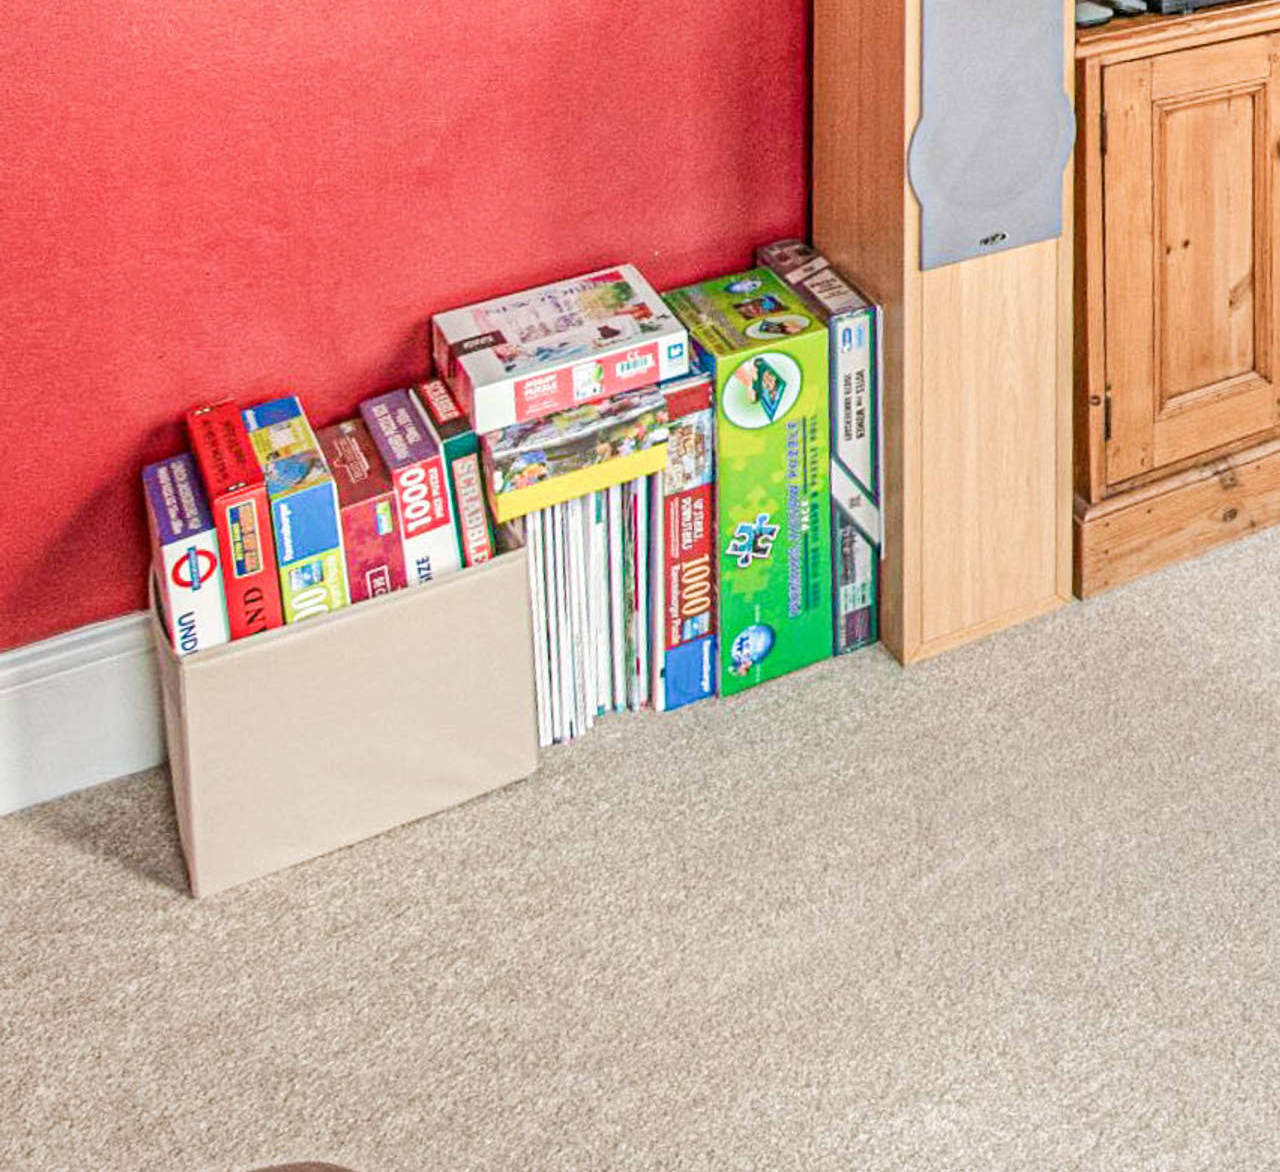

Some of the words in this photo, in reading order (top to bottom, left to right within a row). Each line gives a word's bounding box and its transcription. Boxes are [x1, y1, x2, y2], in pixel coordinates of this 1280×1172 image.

[400, 466, 432, 534] 1000
[459, 460, 489, 564] SCRABBLE
[681, 554, 711, 617] 1000
